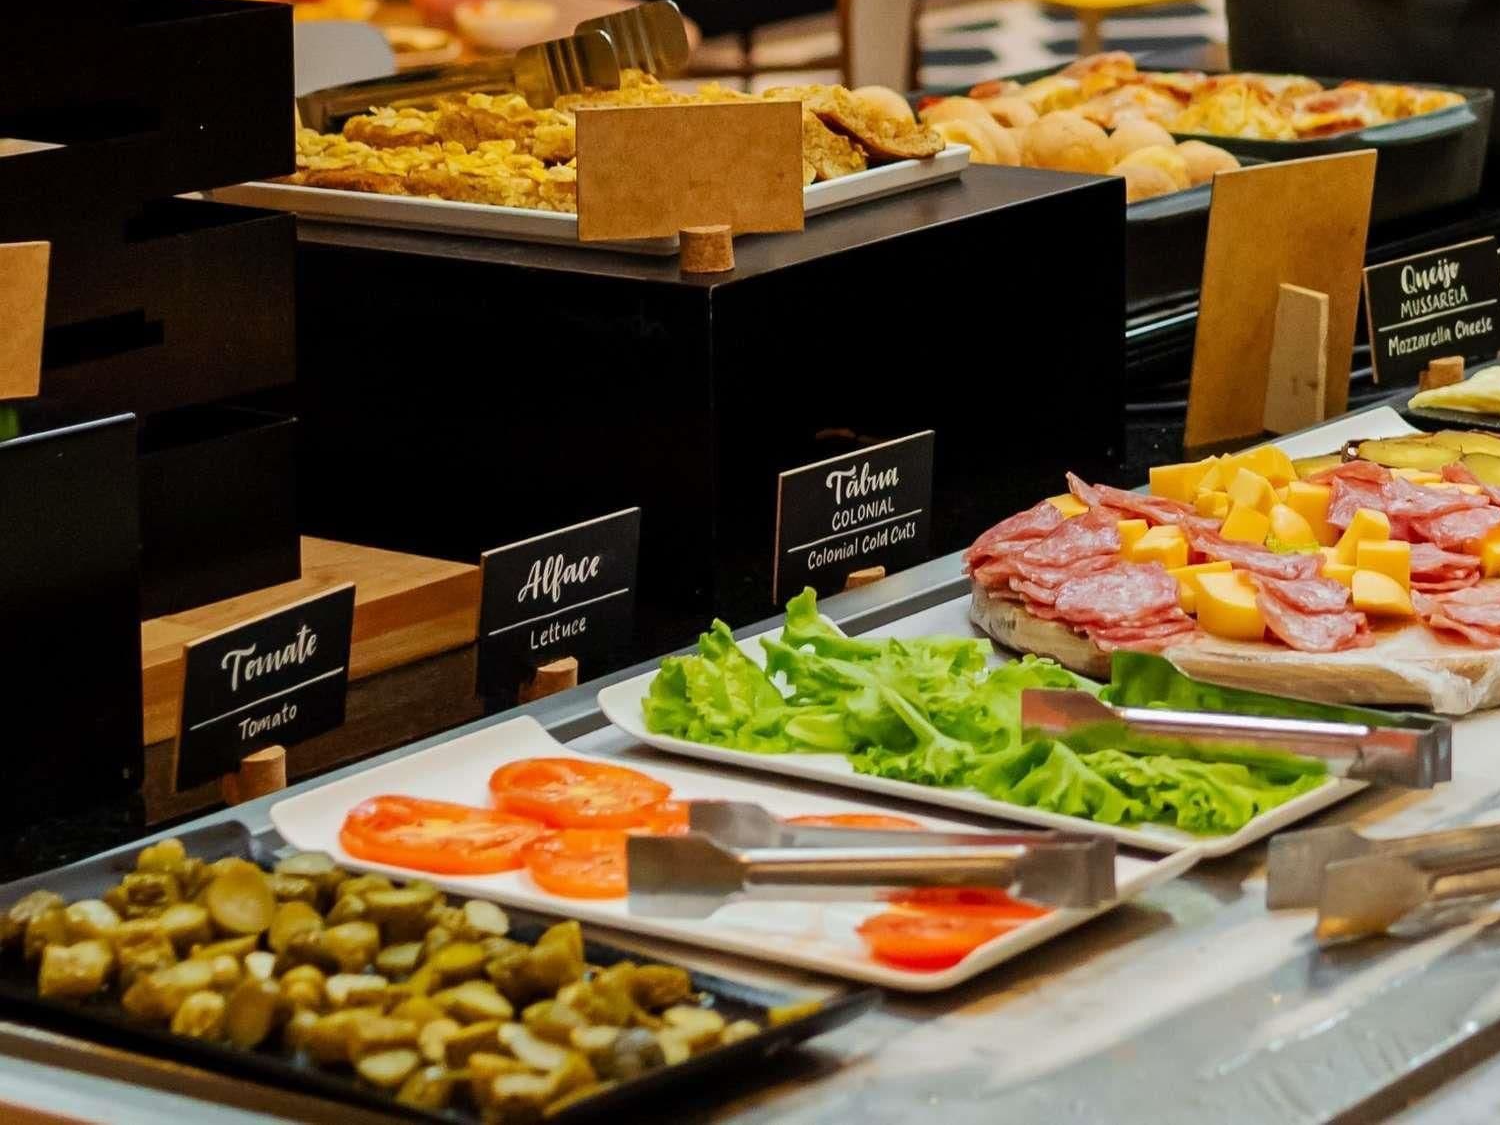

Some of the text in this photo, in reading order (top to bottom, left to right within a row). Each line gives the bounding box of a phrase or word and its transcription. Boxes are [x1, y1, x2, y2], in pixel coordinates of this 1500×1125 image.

[1401, 259, 1460, 295] Queijo
[1400, 285, 1469, 319] MUSSARELA
[1388, 316, 1493, 357] Mozzarella Cheese
[825, 462, 900, 505] Tábua
[832, 496, 895, 531] COLONIAL
[807, 522, 916, 570] Colonial Cold Cuts
[518, 554, 600, 603] Alface
[530, 617, 587, 650] Lettuce
[221, 624, 318, 692] Tomate
[238, 703, 298, 740] Tomato
